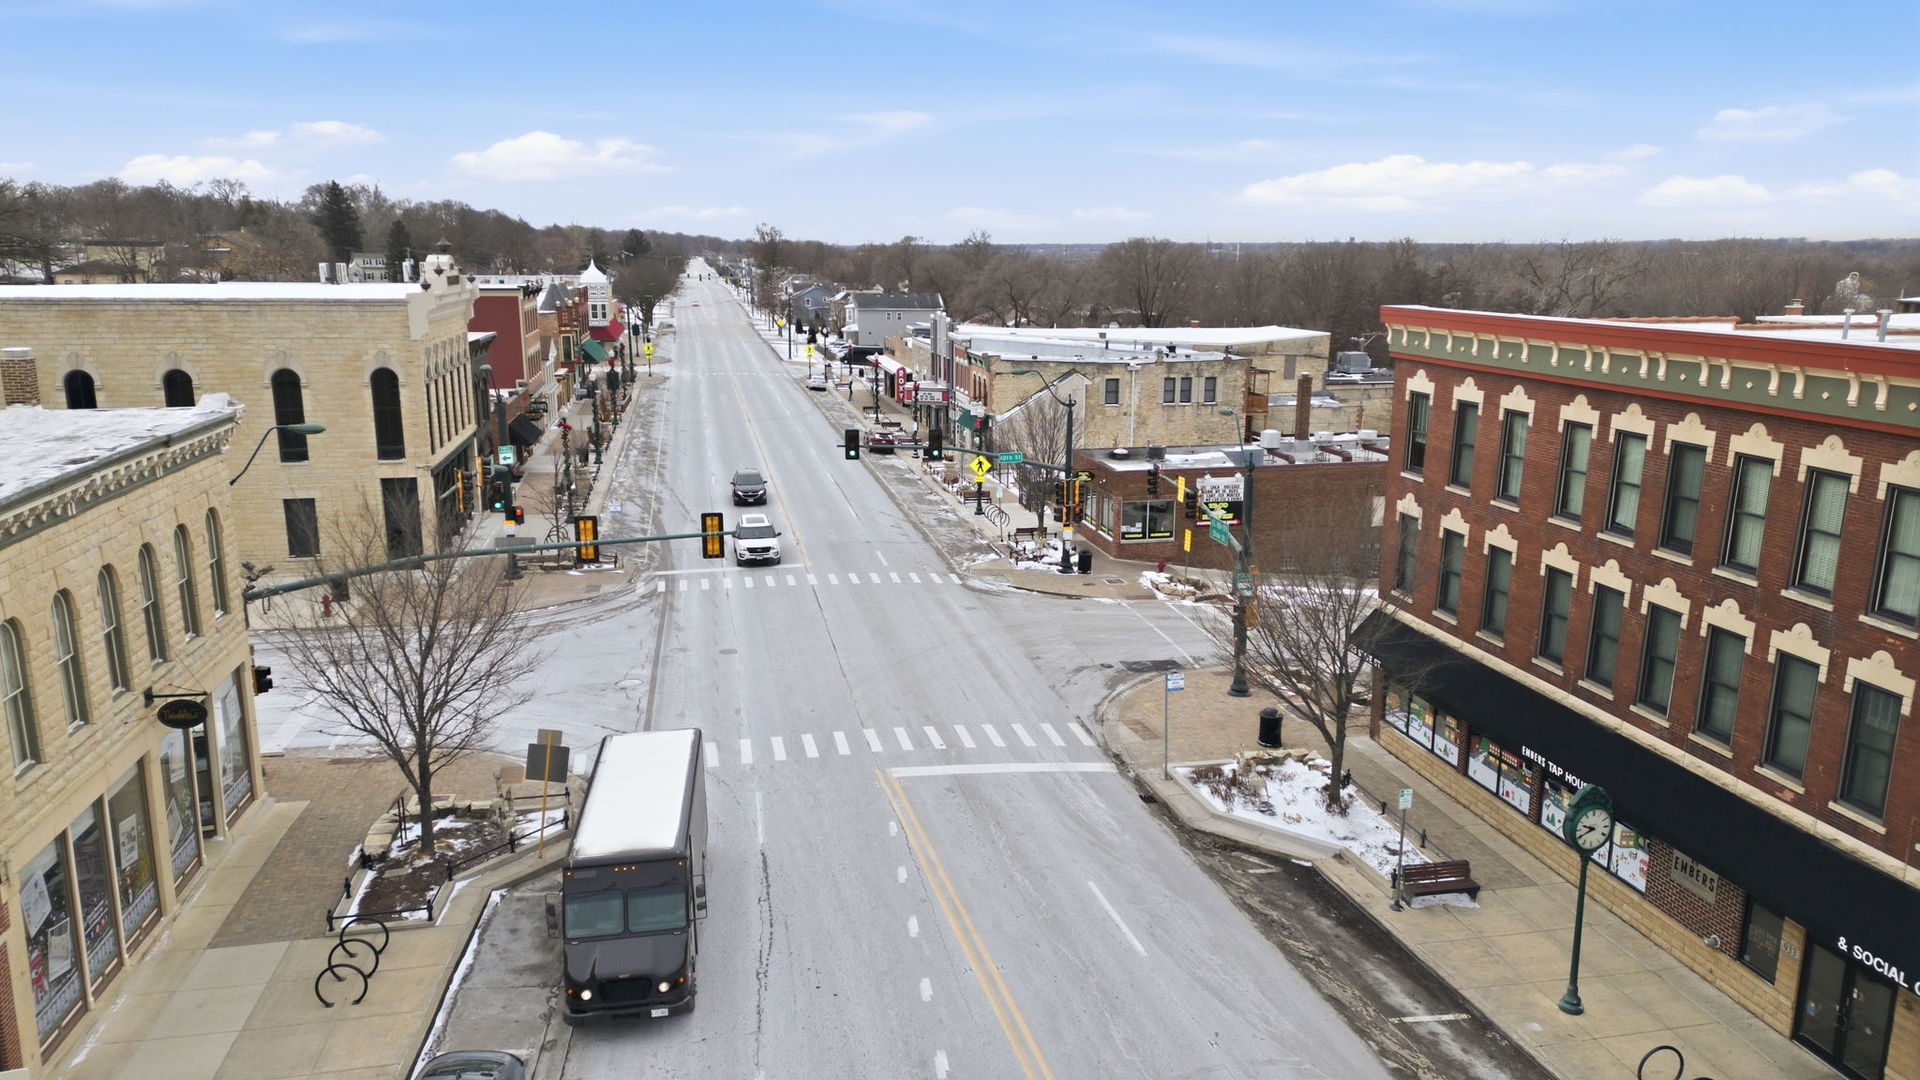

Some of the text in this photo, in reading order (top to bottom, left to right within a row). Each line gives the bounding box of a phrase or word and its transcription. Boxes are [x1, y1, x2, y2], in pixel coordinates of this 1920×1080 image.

[1522, 745, 1546, 768] EMBERS
[1547, 761, 1564, 777] TAP
[1674, 856, 1715, 892] EMBERS
[1837, 936, 1849, 952] &
[1852, 944, 1909, 988] SOCIAL
